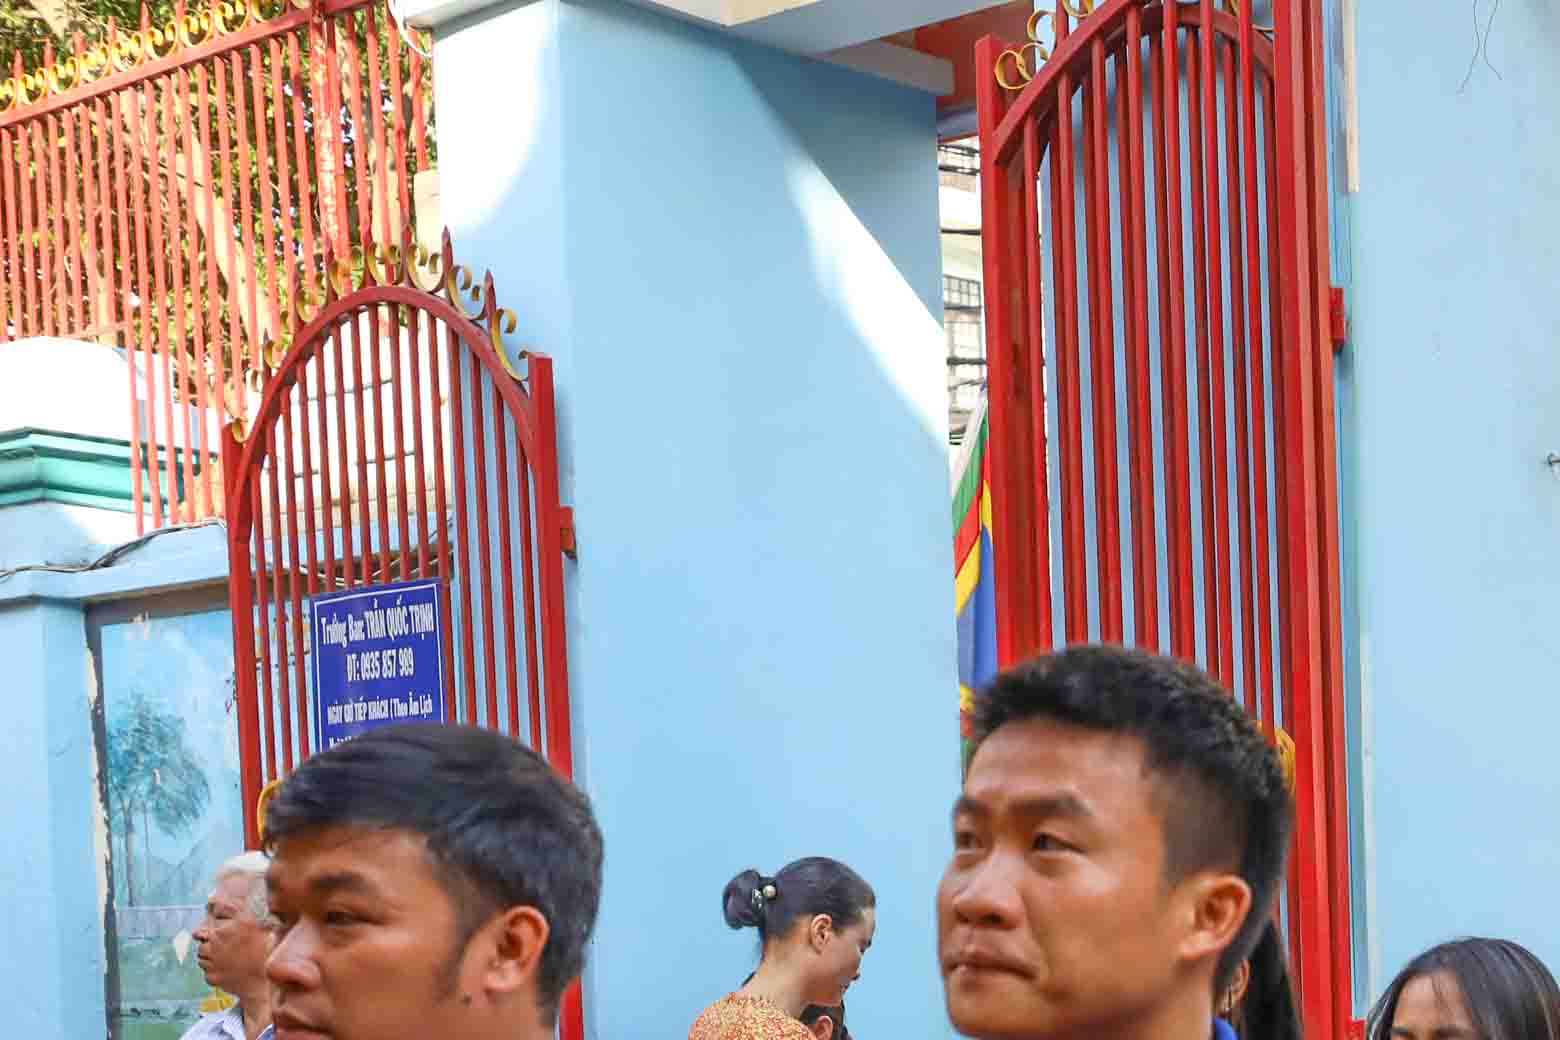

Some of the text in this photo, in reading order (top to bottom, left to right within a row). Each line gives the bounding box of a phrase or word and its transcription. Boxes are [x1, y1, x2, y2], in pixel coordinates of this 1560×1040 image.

[386, 594, 409, 641] QUỐC
[360, 650, 380, 681] 0935
[382, 648, 397, 679] 857
